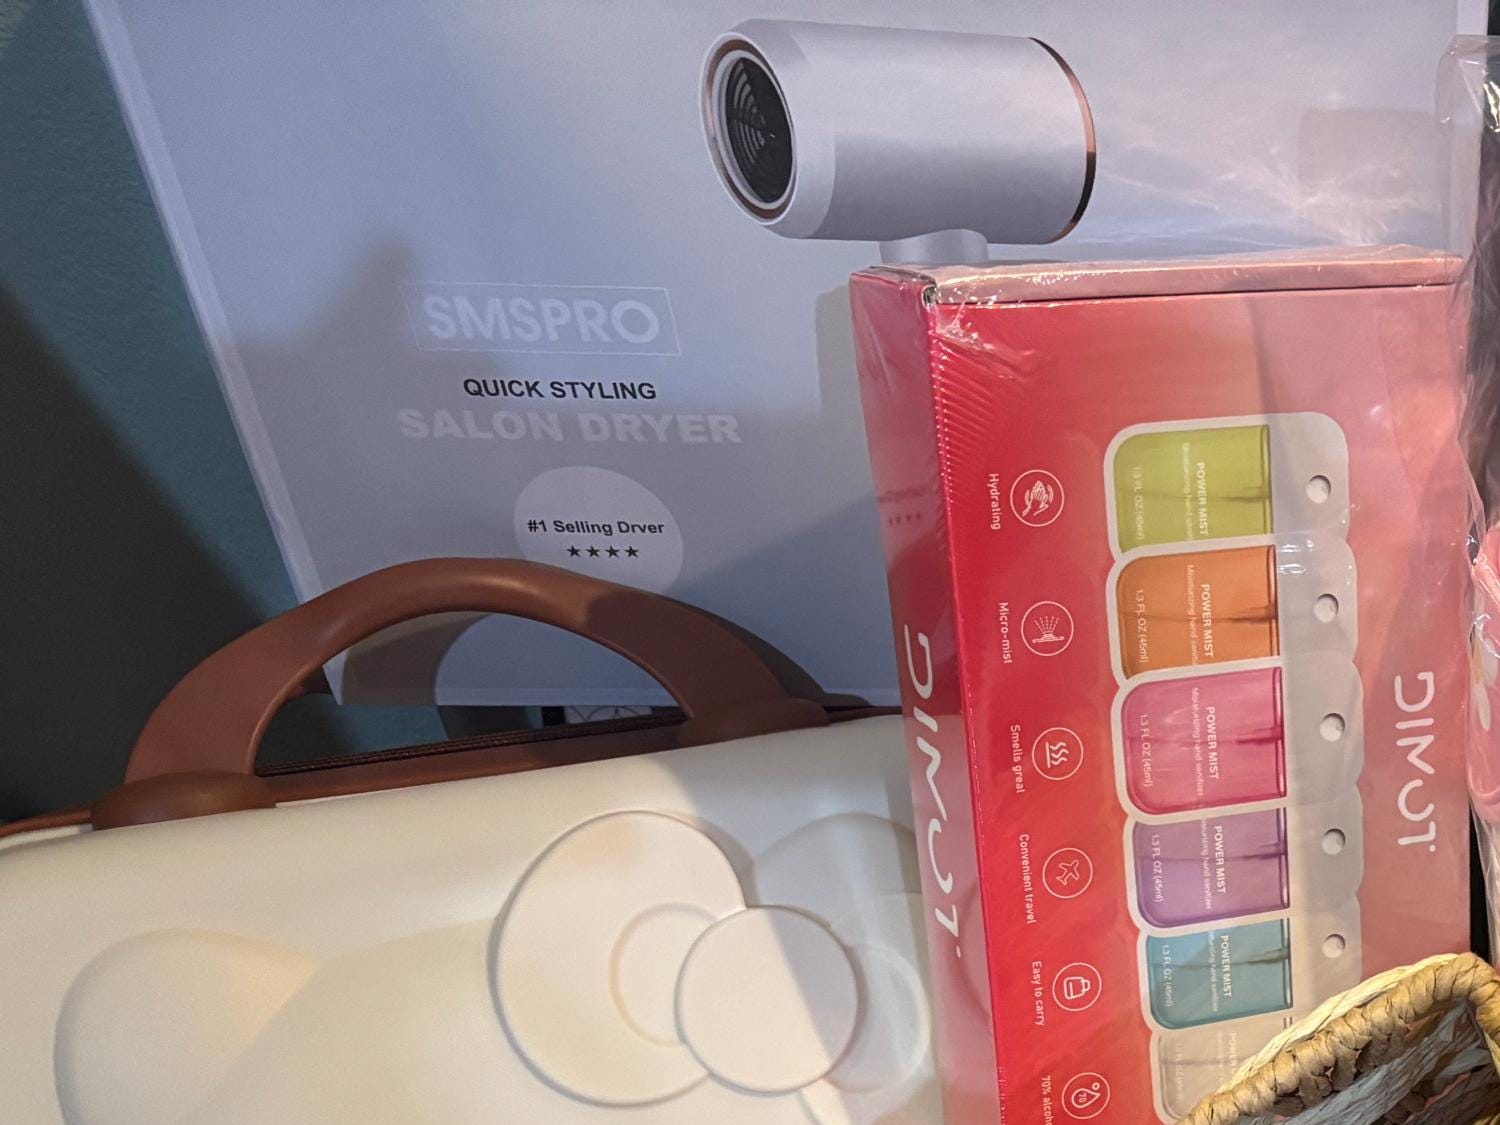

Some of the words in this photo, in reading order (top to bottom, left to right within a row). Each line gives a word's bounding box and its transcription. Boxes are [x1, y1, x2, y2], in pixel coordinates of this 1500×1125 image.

[422, 295, 661, 345] SMSPRO
[463, 378, 542, 399] QUICK
[549, 381, 657, 400] STYLING
[400, 407, 563, 442] SALON
[578, 412, 742, 444] DRYER
[1196, 461, 1207, 505] POWER
[987, 473, 1001, 531] Hydrating
[527, 519, 547, 533] #1
[553, 520, 613, 536] Selling
[1198, 507, 1208, 536] MIST
[1200, 583, 1212, 628] POWER
[999, 602, 1012, 664] Micro-mist
[1137, 618, 1147, 634] OZ
[1203, 629, 1214, 658] MIST
[1141, 727, 1150, 741] FL
[1206, 706, 1217, 749] POWER
[1010, 724, 1024, 763] Smells
[1142, 742, 1151, 758] OZ
[1012, 764, 1026, 793] great
[1143, 758, 1153, 787] (45ml)
[1208, 751, 1219, 780] MIST
[1152, 846, 1161, 859] FL
[1214, 825, 1225, 866] POWER
[1019, 834, 1034, 896] Convenient
[1153, 860, 1163, 875] OZ
[1154, 875, 1165, 903] (45ml)
[1216, 867, 1226, 894] MIST
[1025, 896, 1036, 924] travel
[1220, 935, 1231, 973] POWER
[1031, 960, 1042, 985] Easy
[1222, 974, 1232, 998] MIST
[1034, 986, 1044, 998] to
[1035, 1000, 1046, 1027] carry
[1041, 1075, 1051, 1096] 70%
